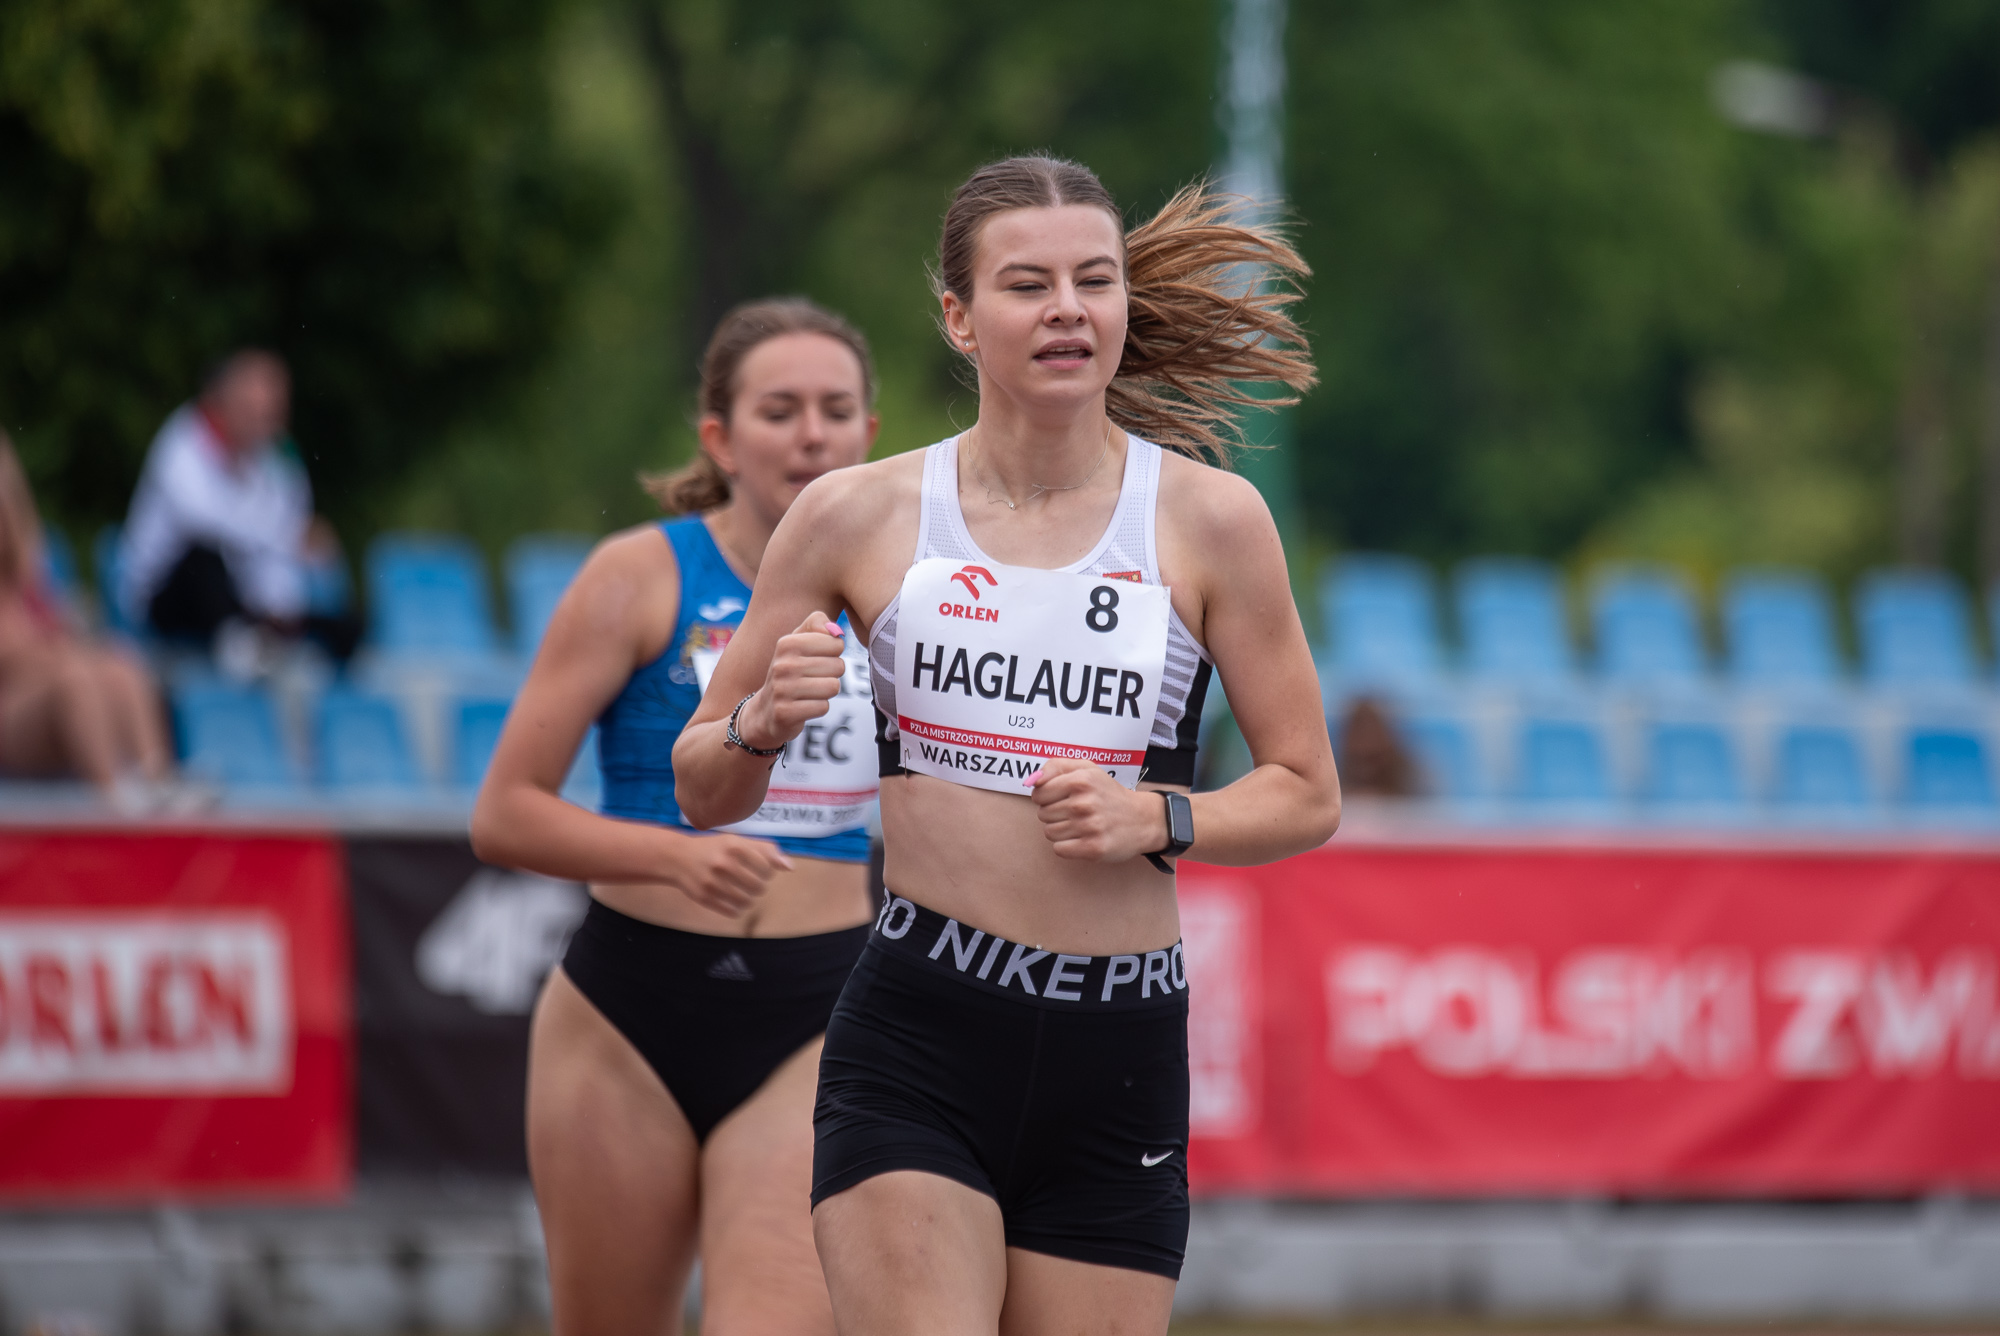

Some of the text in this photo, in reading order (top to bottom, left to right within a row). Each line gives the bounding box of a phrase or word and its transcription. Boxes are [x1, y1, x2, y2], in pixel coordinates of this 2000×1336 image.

[938, 602, 999, 623] ORLEN
[1085, 585, 1119, 633] 8
[912, 641, 1144, 719] HAGLAUER
[910, 722, 1132, 763] PZLA MISTRZOSTWA POLSKI W WIELOBOJACH 2023
[1008, 714, 1035, 729] U23
[919, 741, 1041, 780] WARSZAW
[927, 919, 1093, 1002] NIKE
[1101, 942, 1187, 1002] PRO
[1322, 943, 1757, 1077] POLSKI
